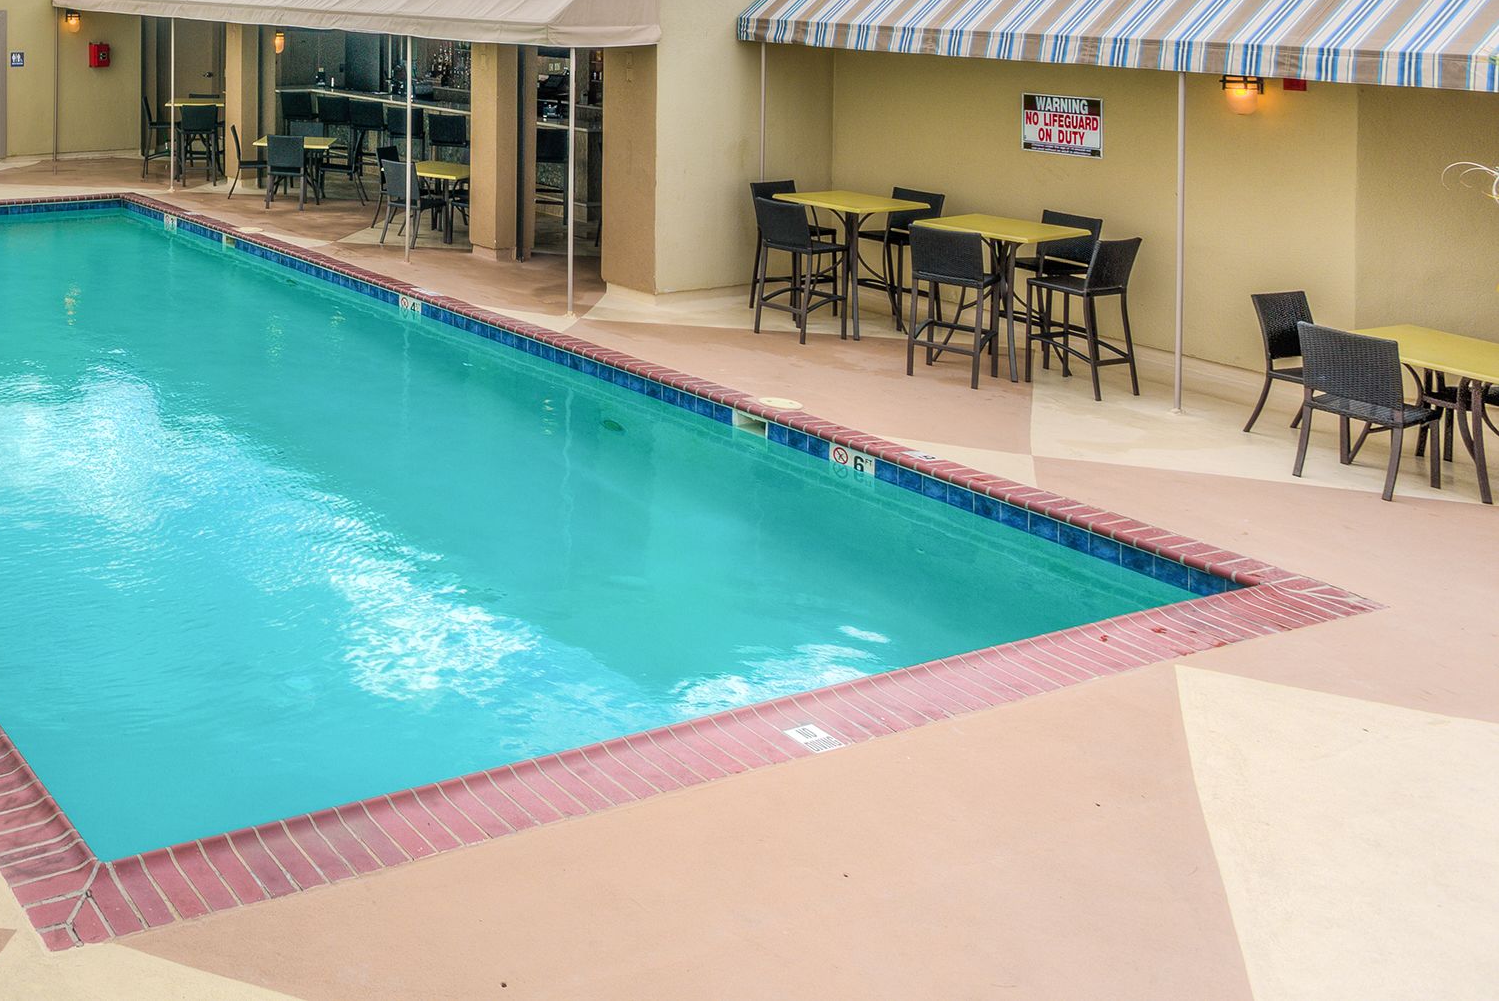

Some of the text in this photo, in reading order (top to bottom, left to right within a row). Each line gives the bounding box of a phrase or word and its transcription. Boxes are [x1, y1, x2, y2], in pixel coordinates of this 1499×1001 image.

[1036, 96, 1088, 114] WARNING
[1025, 112, 1098, 131] NO LIFEGUARD
[1038, 128, 1085, 145] ON DUTY
[411, 302, 415, 311] 4
[854, 456, 872, 472] 6 FT
[795, 728, 817, 739] NO
